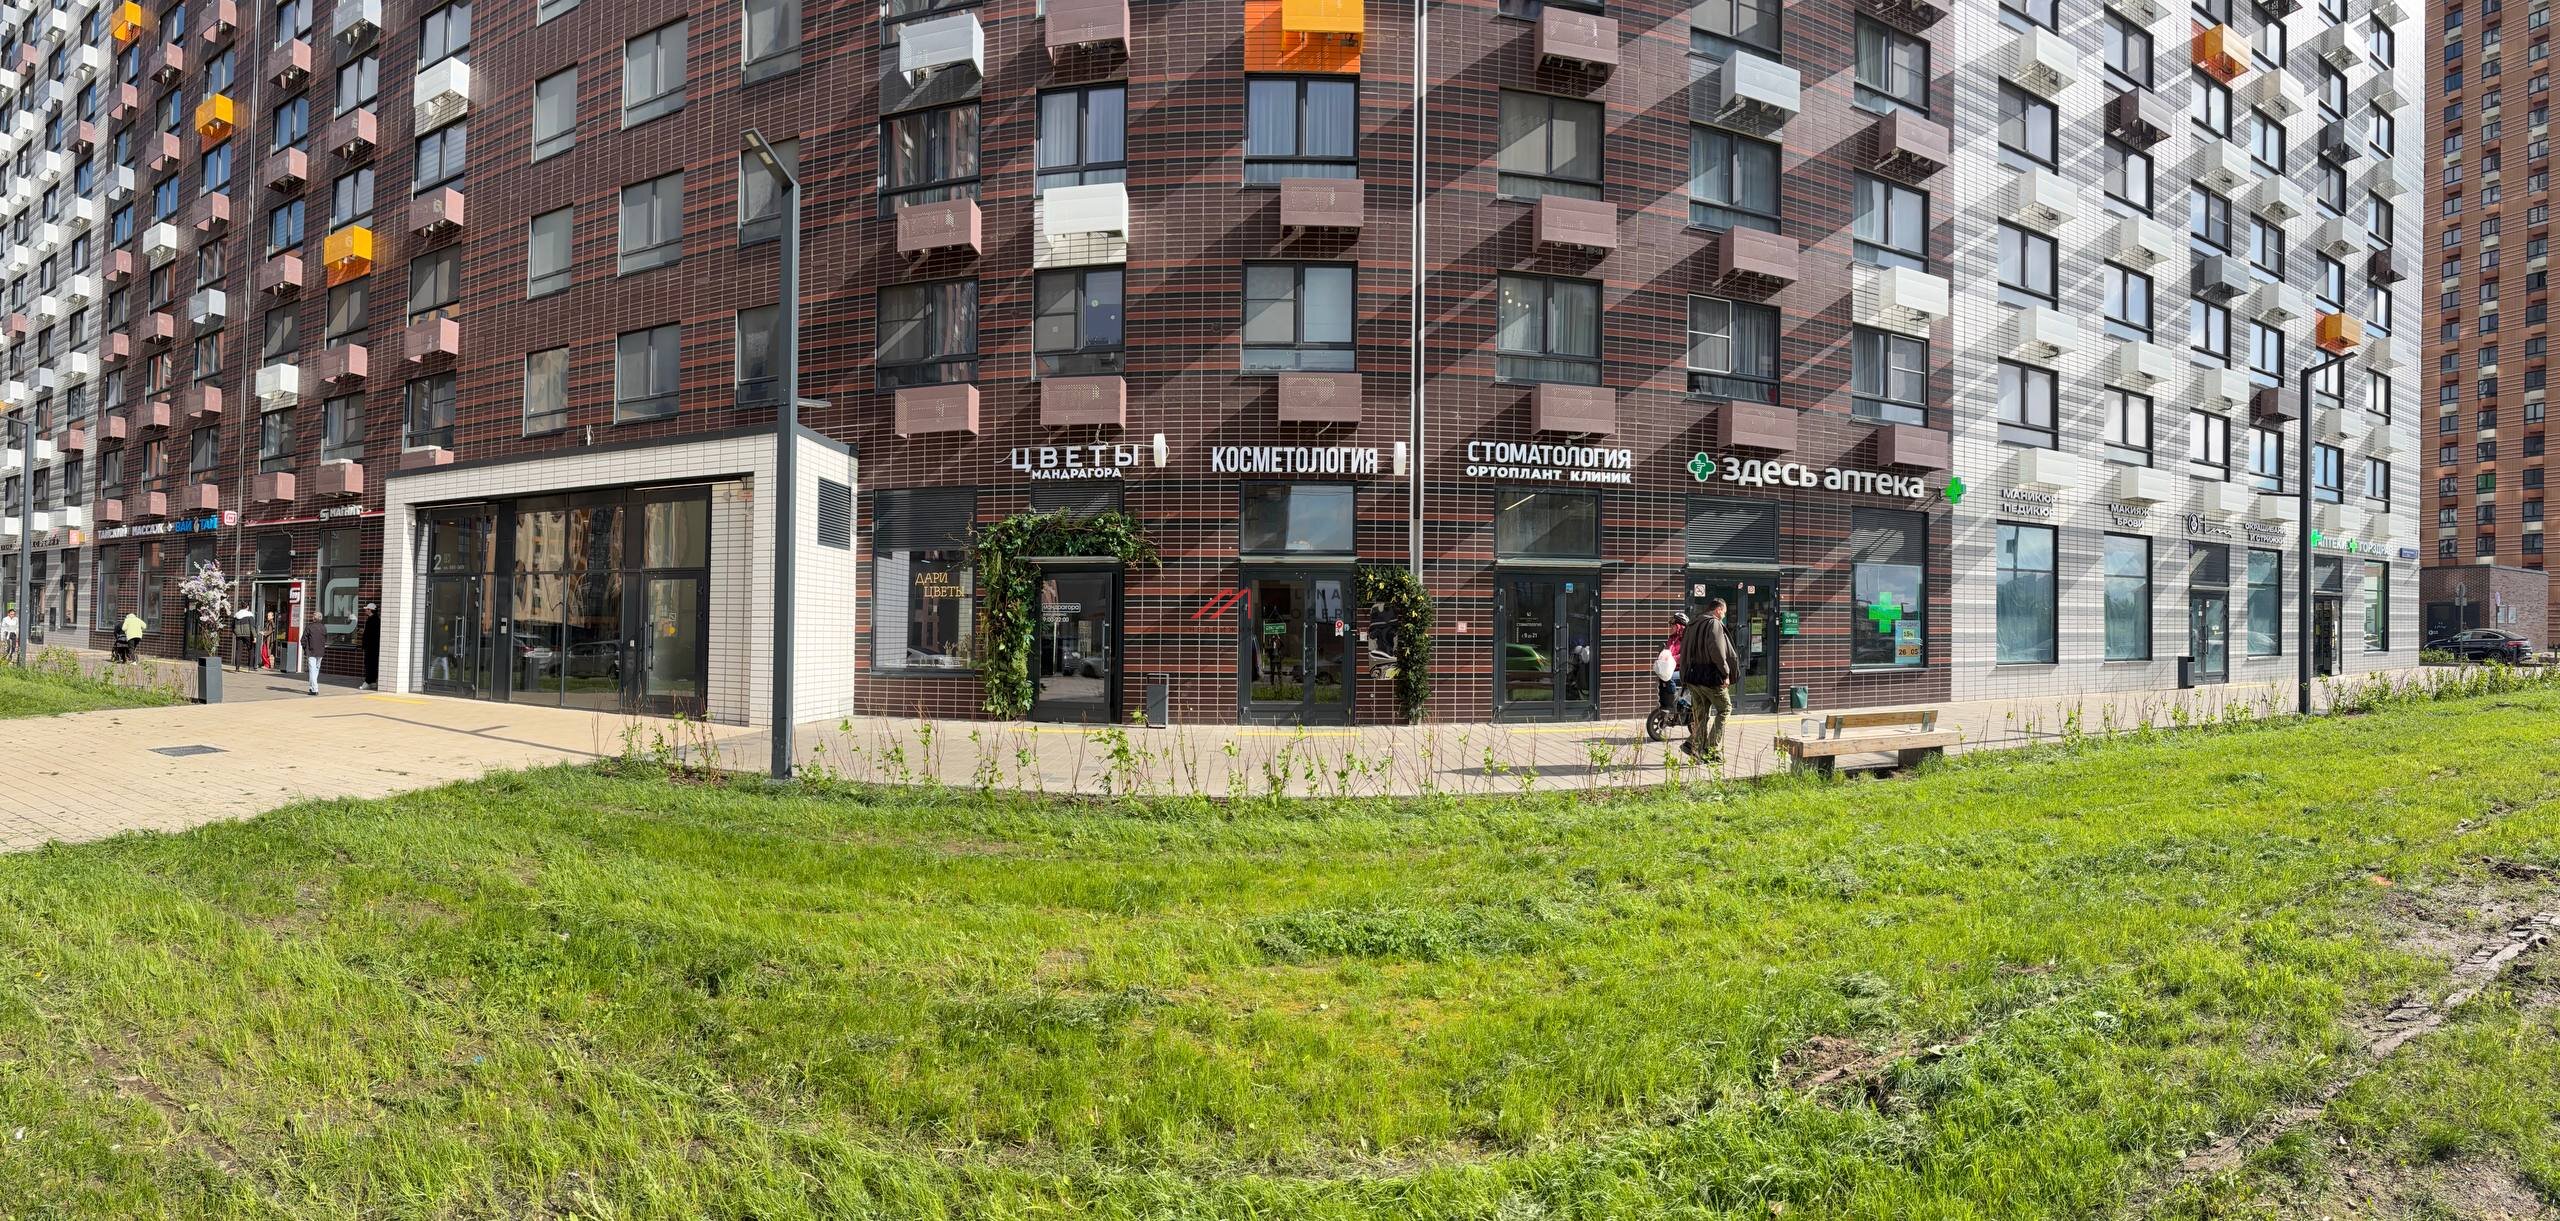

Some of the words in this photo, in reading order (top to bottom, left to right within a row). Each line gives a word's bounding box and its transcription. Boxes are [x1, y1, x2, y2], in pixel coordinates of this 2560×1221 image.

[1011, 445, 1140, 473] ЦВЕТЫ
[1211, 446, 1378, 474] КОСМЕТОЛОГИЯ
[1467, 440, 1632, 469] СТОМАТОЛОГИЯ
[1031, 467, 1122, 480] МАНДРАГОРА
[1466, 465, 1562, 481] ОРТОПЛАНТ
[1569, 470, 1632, 484] КЛИНИК
[1823, 467, 1925, 498] аптека
[2001, 489, 2057, 504] МАНИКЮР
[330, 504, 363, 518] МАГНИТ
[2002, 502, 2056, 518] ПЕДИКЮР
[2109, 503, 2151, 518] МАКИЯЖ
[2116, 517, 2145, 529] БРОВИ
[97, 524, 128, 540] ТАЙСКИЙ
[131, 522, 165, 537] МАССАЖ
[433, 554, 441, 569] 2
[914, 572, 948, 586] ДАРИ
[924, 585, 965, 599] ЦВЕТЫ
